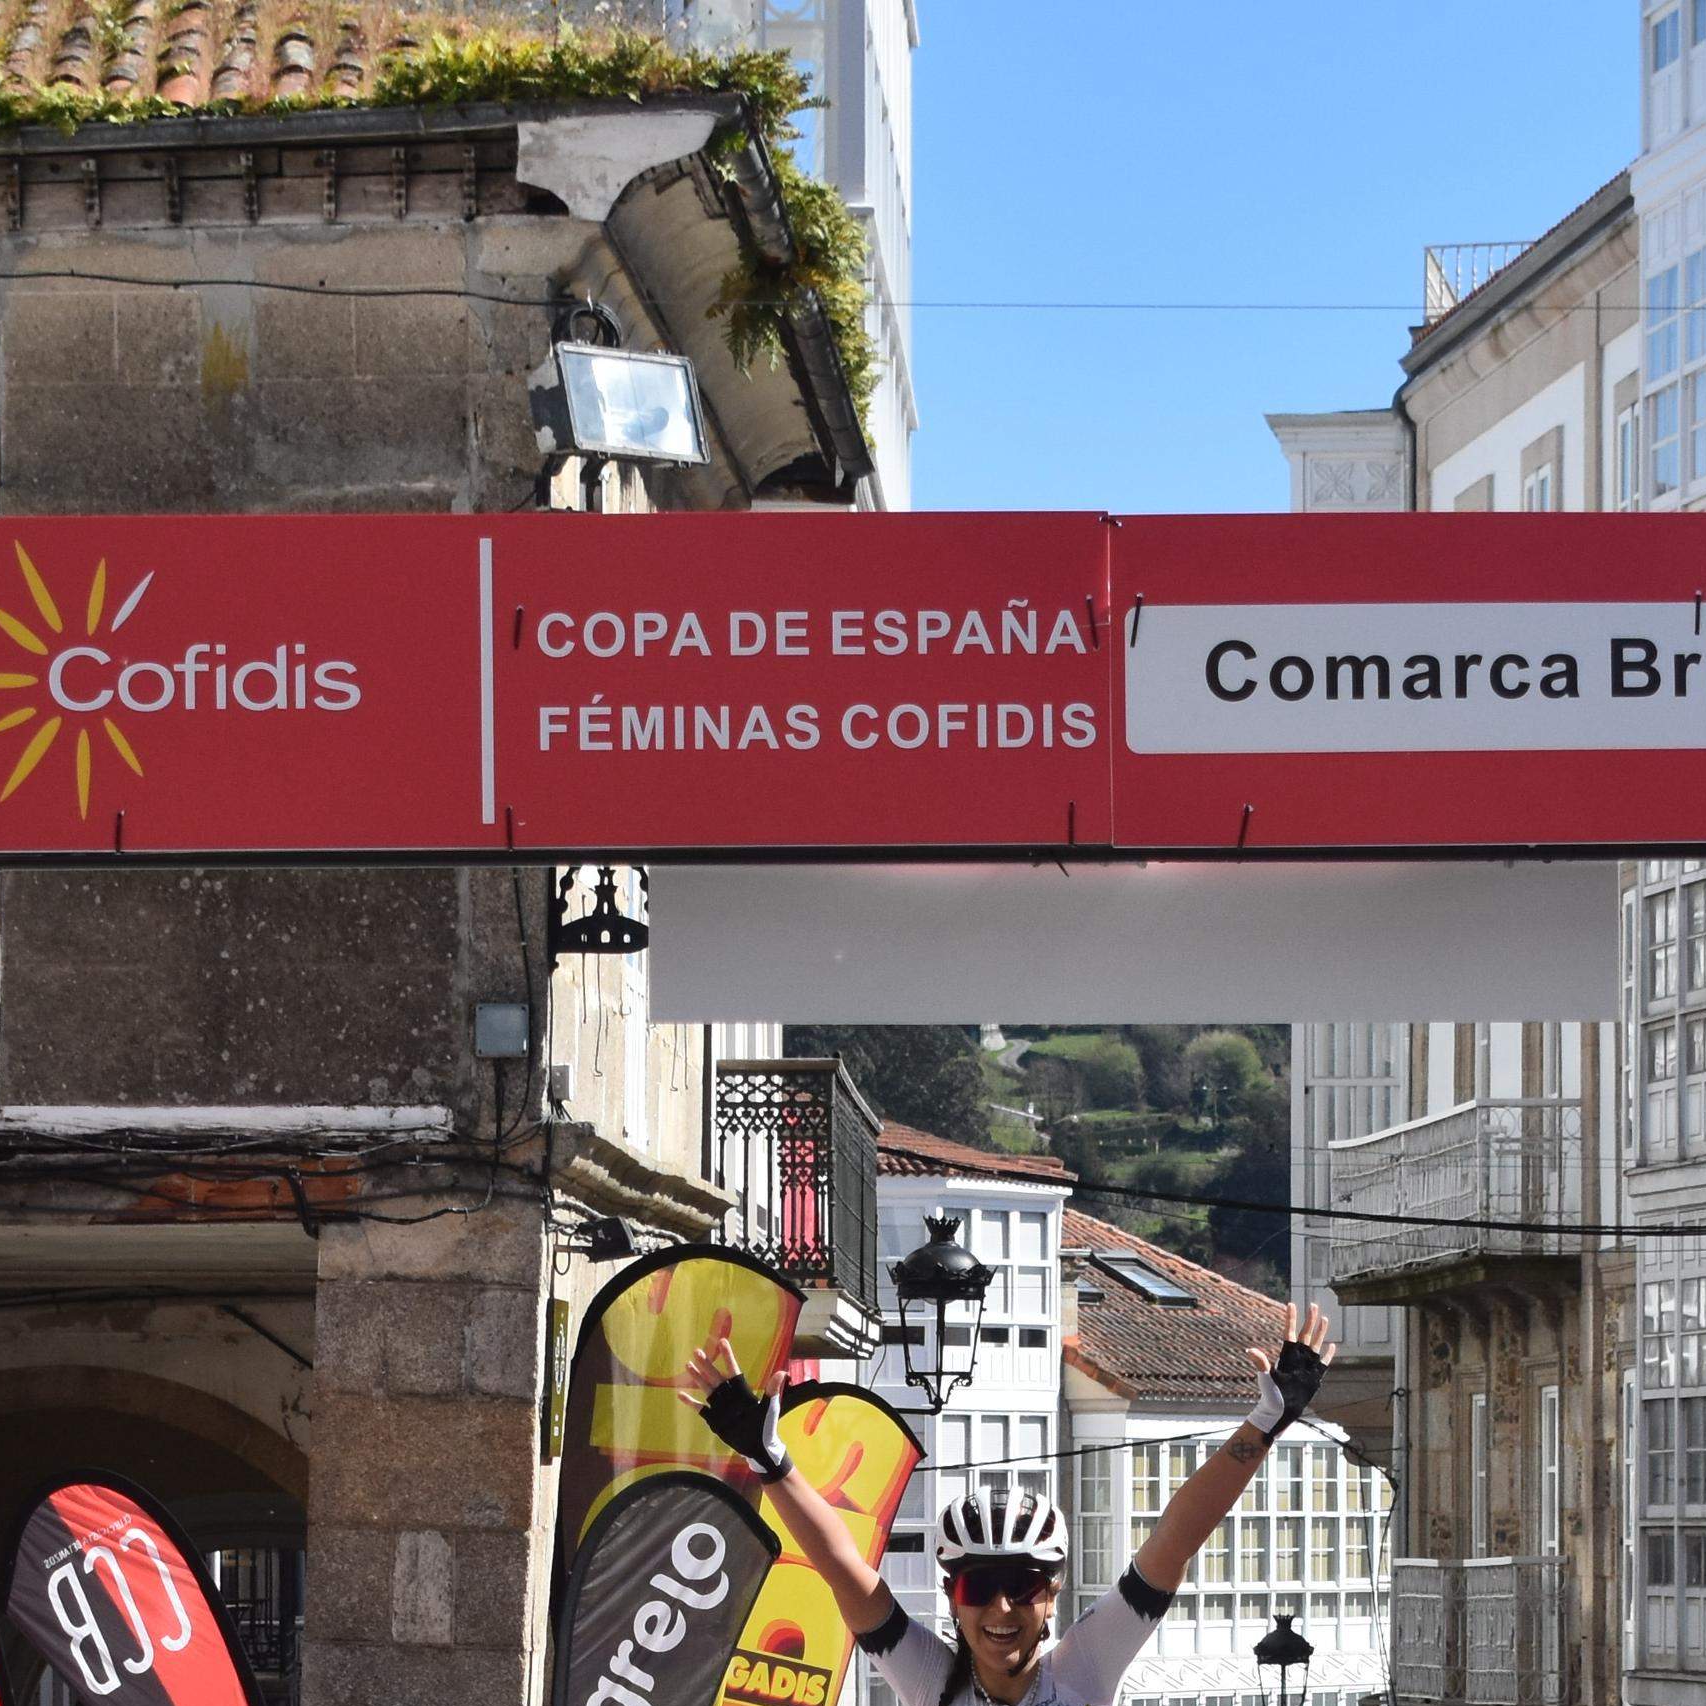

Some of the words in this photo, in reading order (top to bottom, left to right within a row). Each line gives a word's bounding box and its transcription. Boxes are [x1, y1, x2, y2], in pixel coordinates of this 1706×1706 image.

[538, 609, 711, 658] COPA
[728, 609, 810, 657] DE
[829, 598, 1087, 656] ESPAÑA
[46, 641, 363, 714] Cofidis
[1202, 637, 1583, 701] Comarca
[539, 692, 821, 752] FÉMINAS
[840, 702, 1099, 750] COFIDIS
